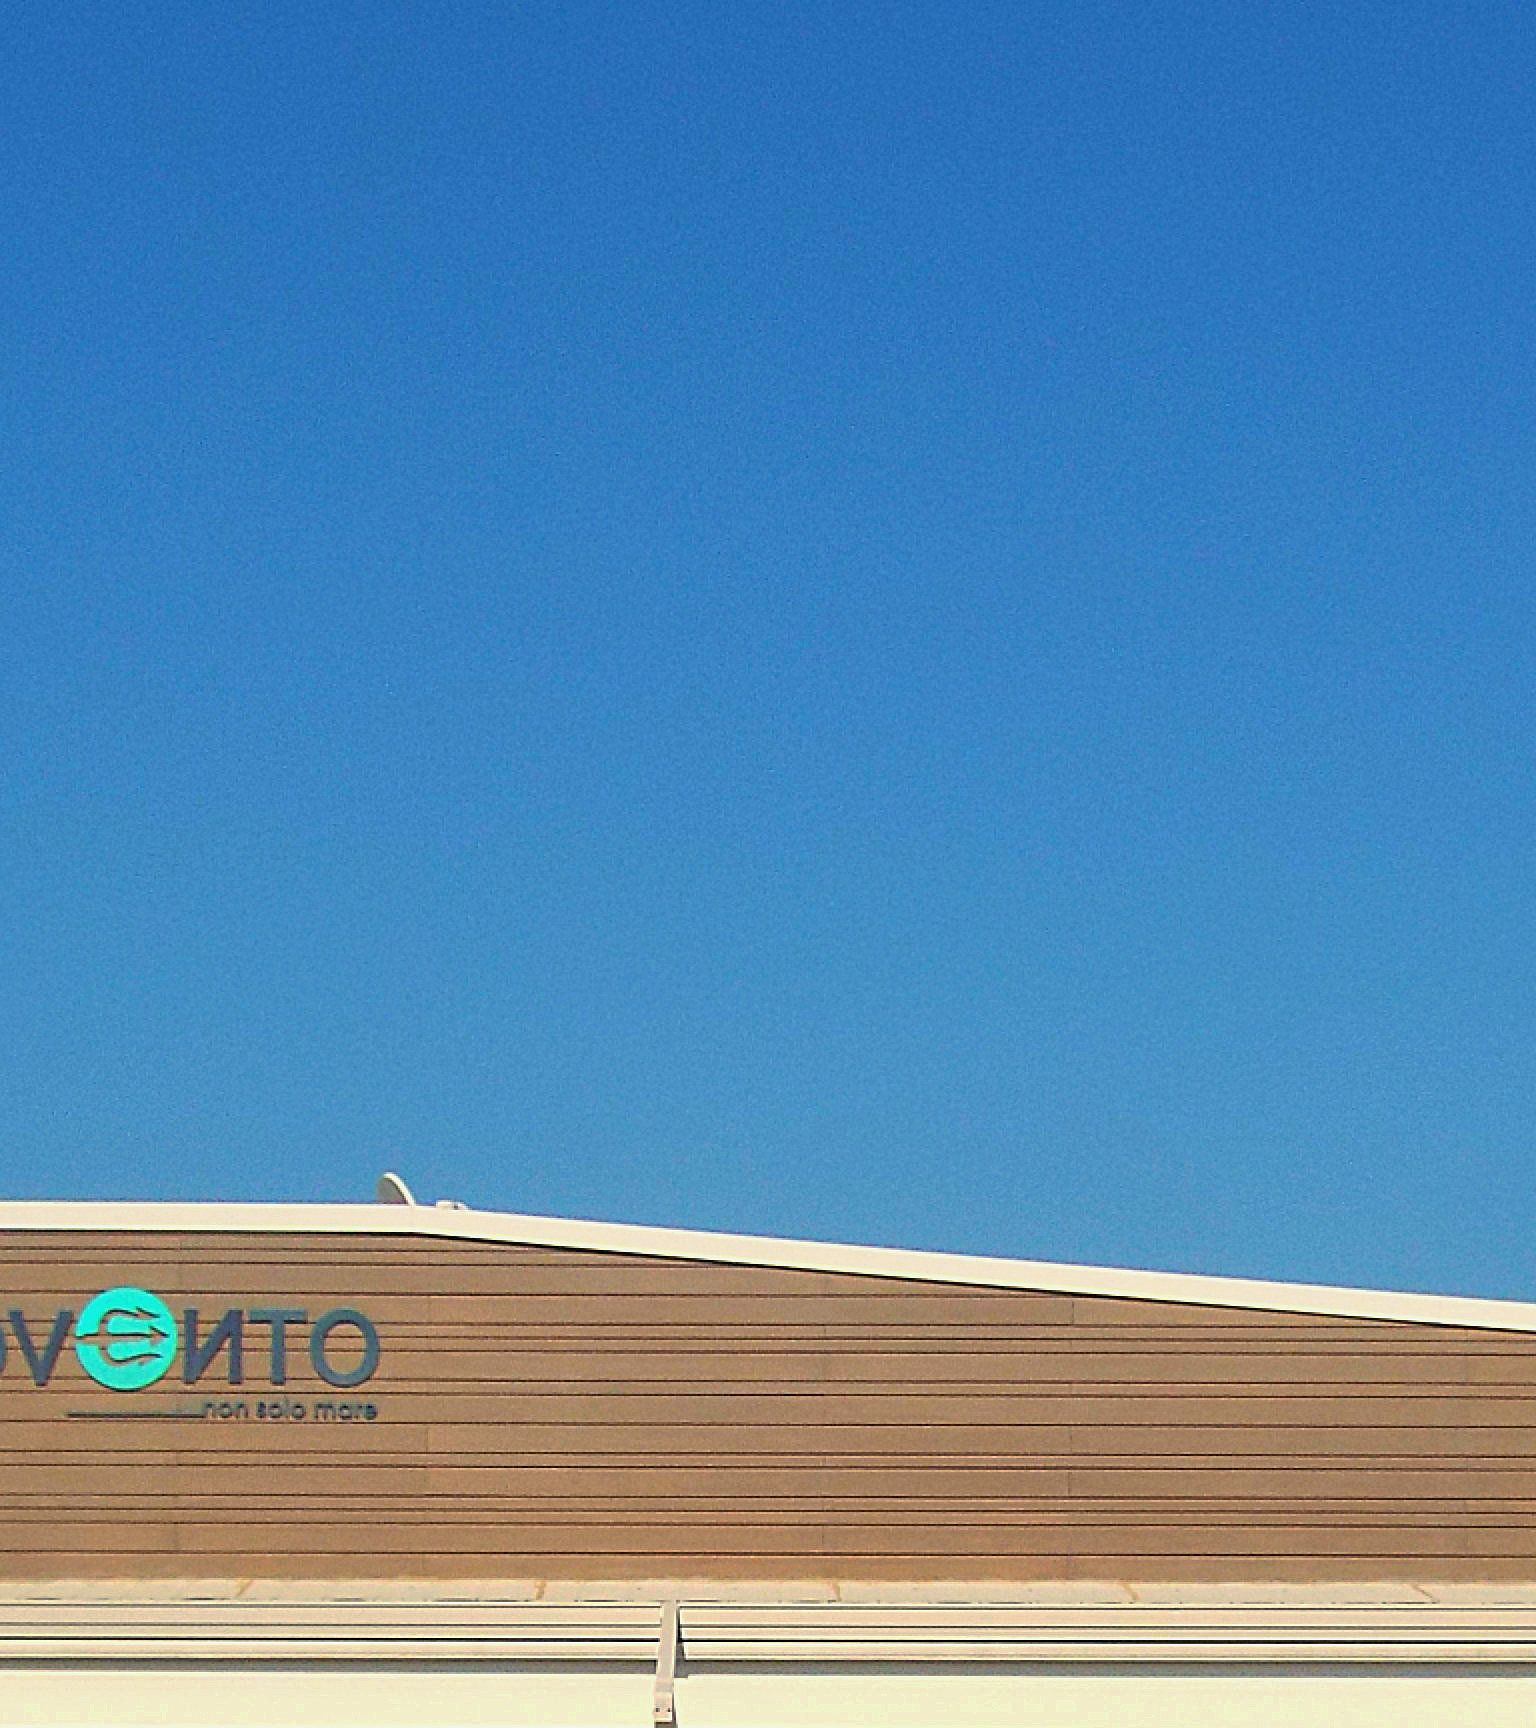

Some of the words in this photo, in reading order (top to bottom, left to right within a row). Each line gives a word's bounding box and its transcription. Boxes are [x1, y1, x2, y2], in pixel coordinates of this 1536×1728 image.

[205, 1402, 249, 1420] non
[256, 1396, 306, 1420] solo
[314, 1402, 378, 1420] mare
